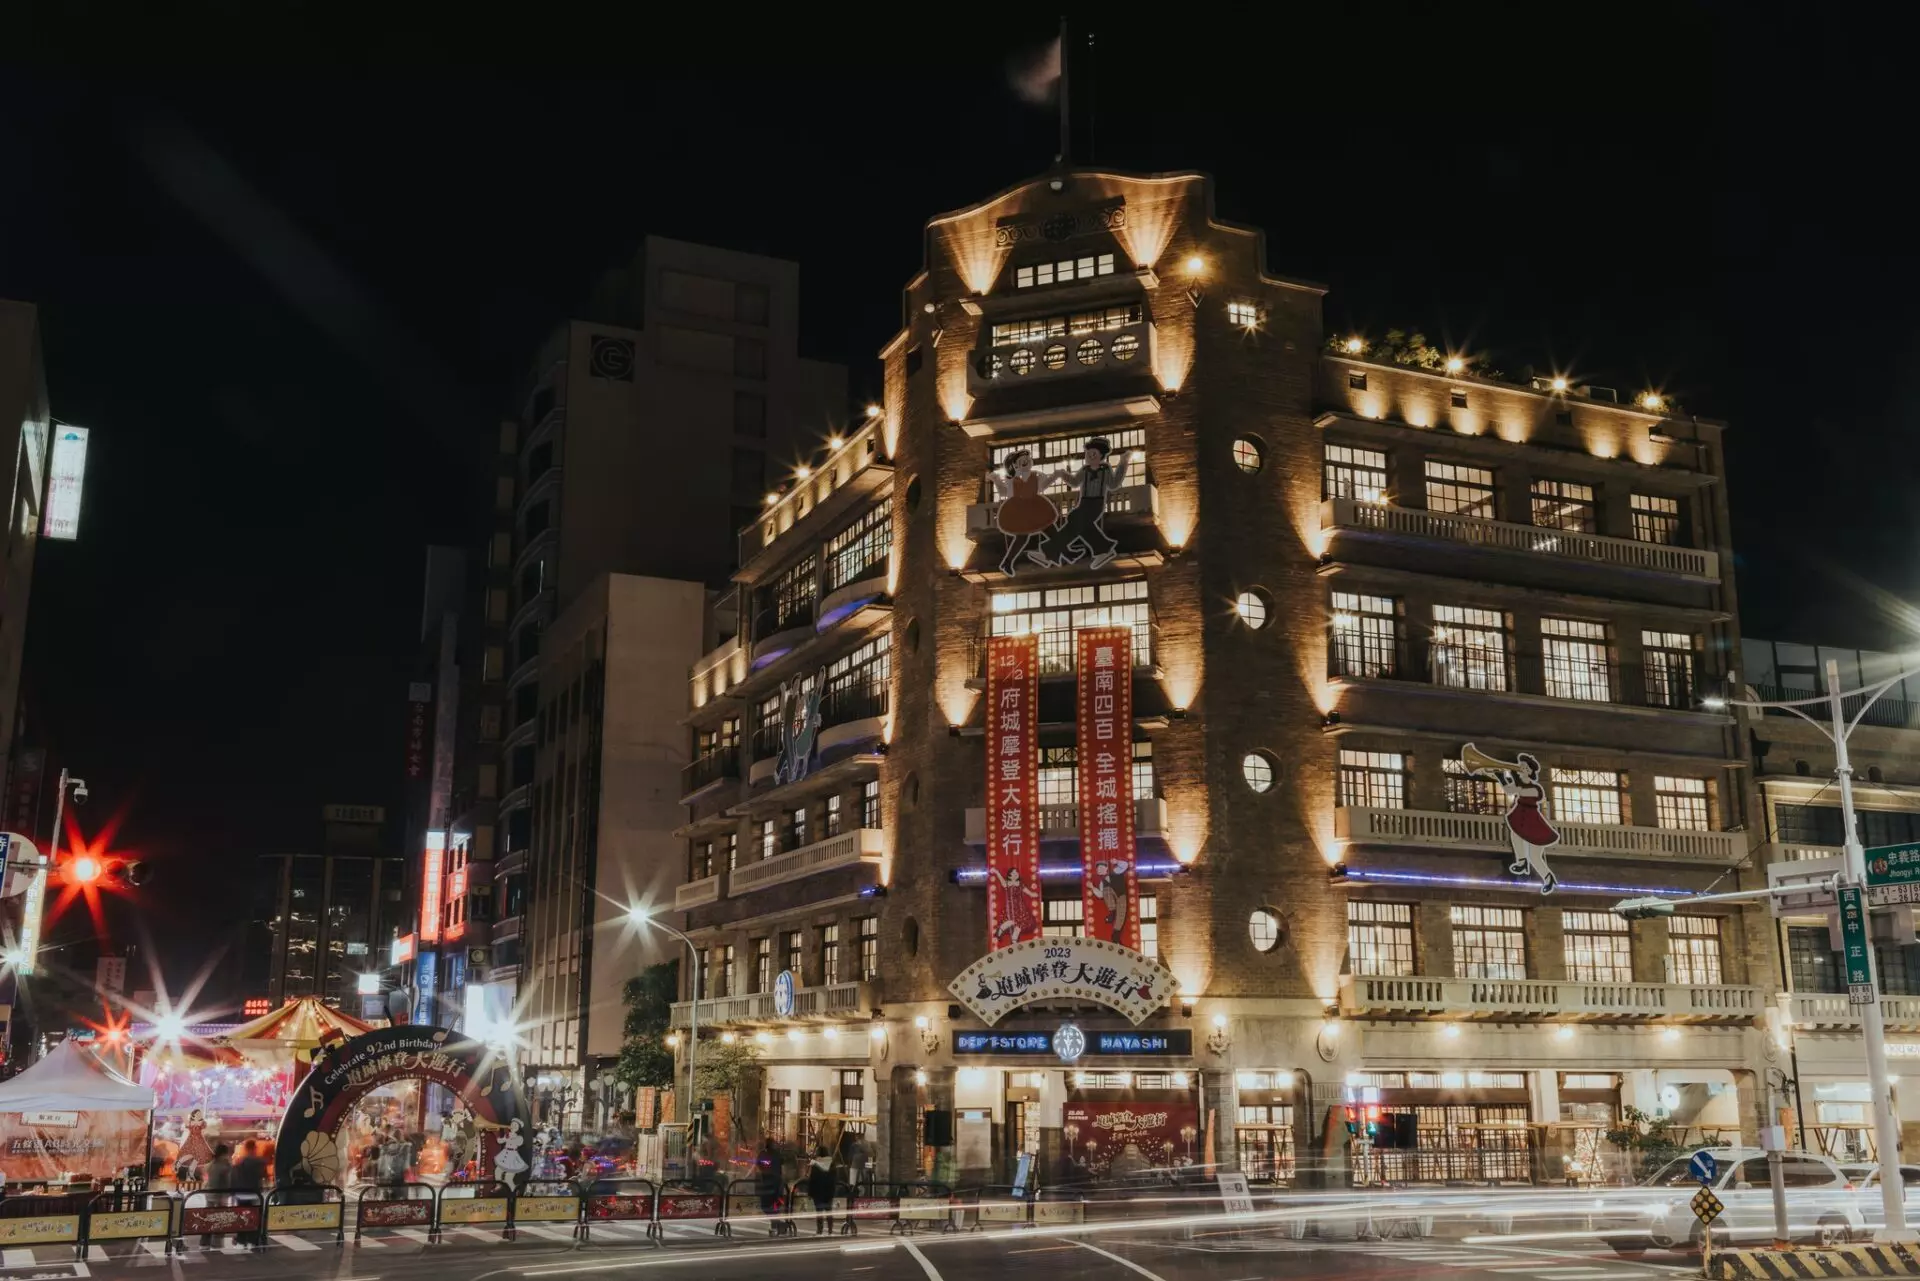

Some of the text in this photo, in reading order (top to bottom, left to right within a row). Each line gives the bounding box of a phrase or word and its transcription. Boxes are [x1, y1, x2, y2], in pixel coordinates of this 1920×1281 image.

[1000, 688, 1022, 856] 府城摩登大遊行
[1888, 850, 1920, 866] 忠義路
[1844, 889, 1855, 901] 西
[1044, 947, 1071, 959] 2023
[1847, 921, 1865, 982] 中正路
[991, 960, 1141, 1000] 府城摩登大遊行
[324, 1038, 443, 1085] Celebrate 92nd Birthday!
[1101, 1037, 1168, 1049] HAYASHI
[342, 1050, 467, 1092] 府城摩登大遊行
